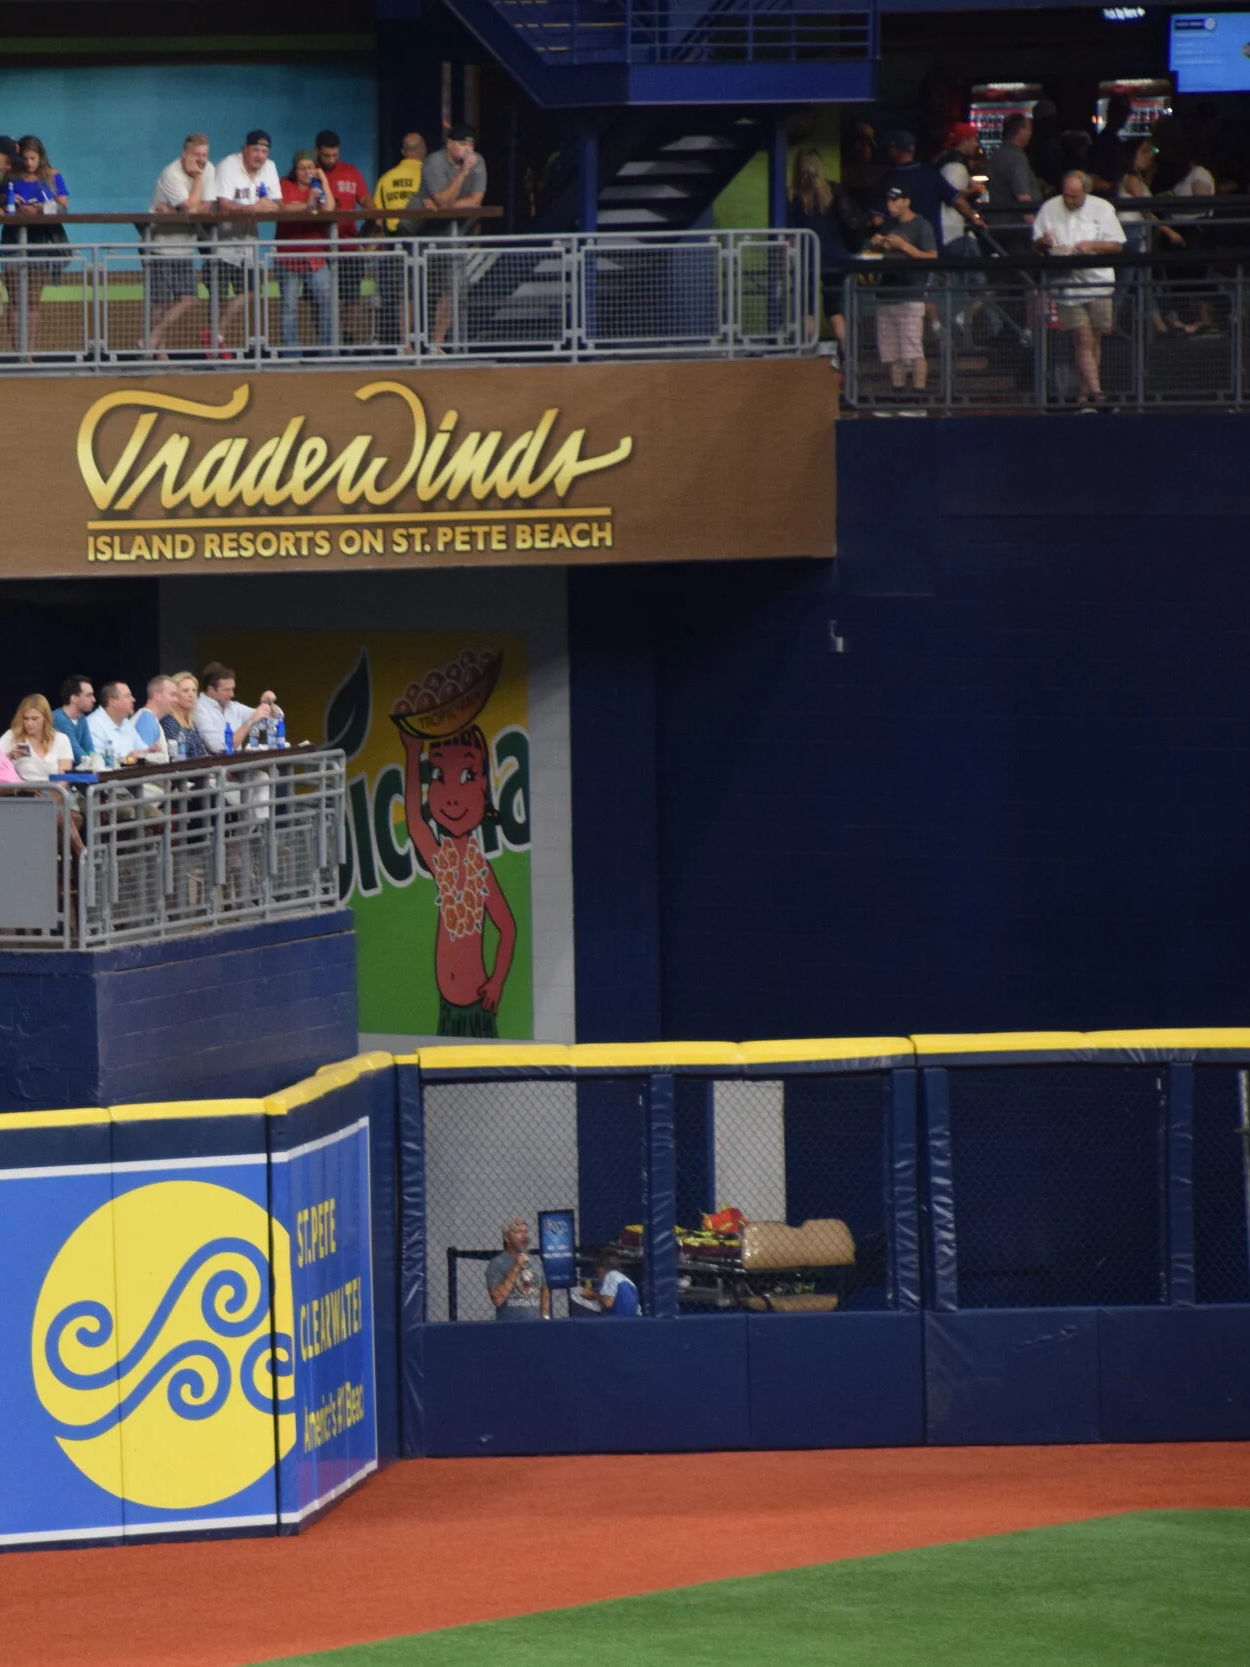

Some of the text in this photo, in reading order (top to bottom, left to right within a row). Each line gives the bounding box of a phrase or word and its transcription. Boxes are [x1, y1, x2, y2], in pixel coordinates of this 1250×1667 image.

[78, 382, 632, 511] TradeWinds
[87, 521, 613, 562] ISLAND RESORTS ON ST. PETE BEACH
[301, 1277, 362, 1363] CLEARWATE
[304, 1392, 336, 1454] Americ's
